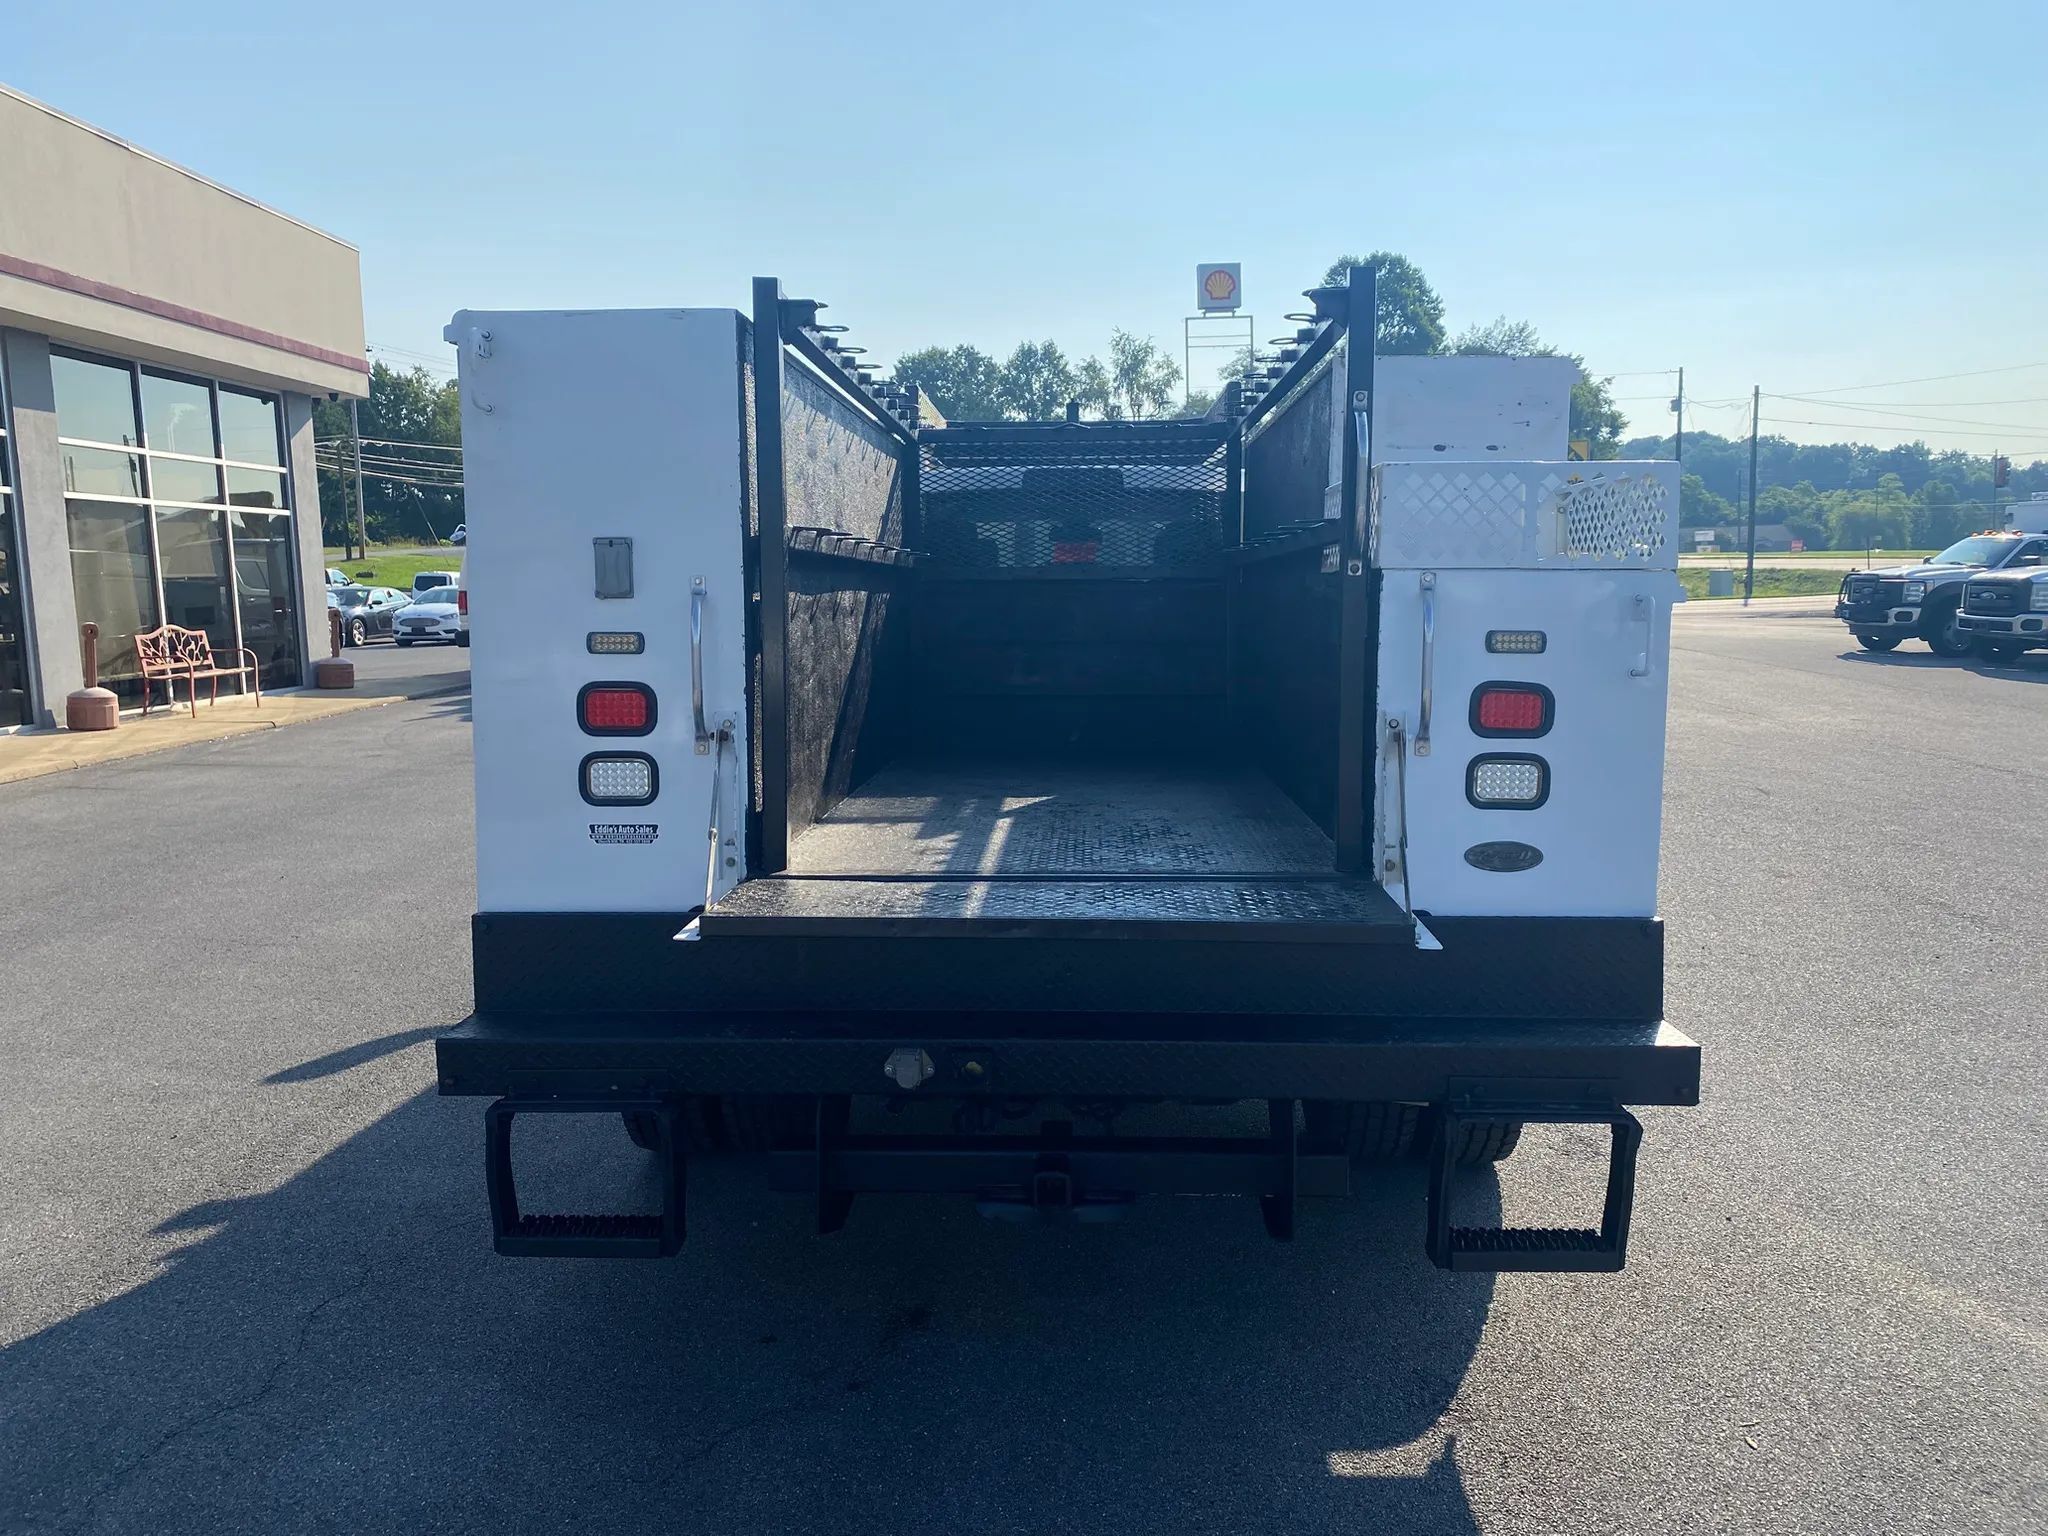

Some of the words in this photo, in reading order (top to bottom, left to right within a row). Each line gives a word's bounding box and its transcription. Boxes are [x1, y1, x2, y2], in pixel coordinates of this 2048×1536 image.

[594, 825, 617, 833] Eddie's
[619, 825, 635, 833] Auto
[635, 825, 653, 833] Sales
